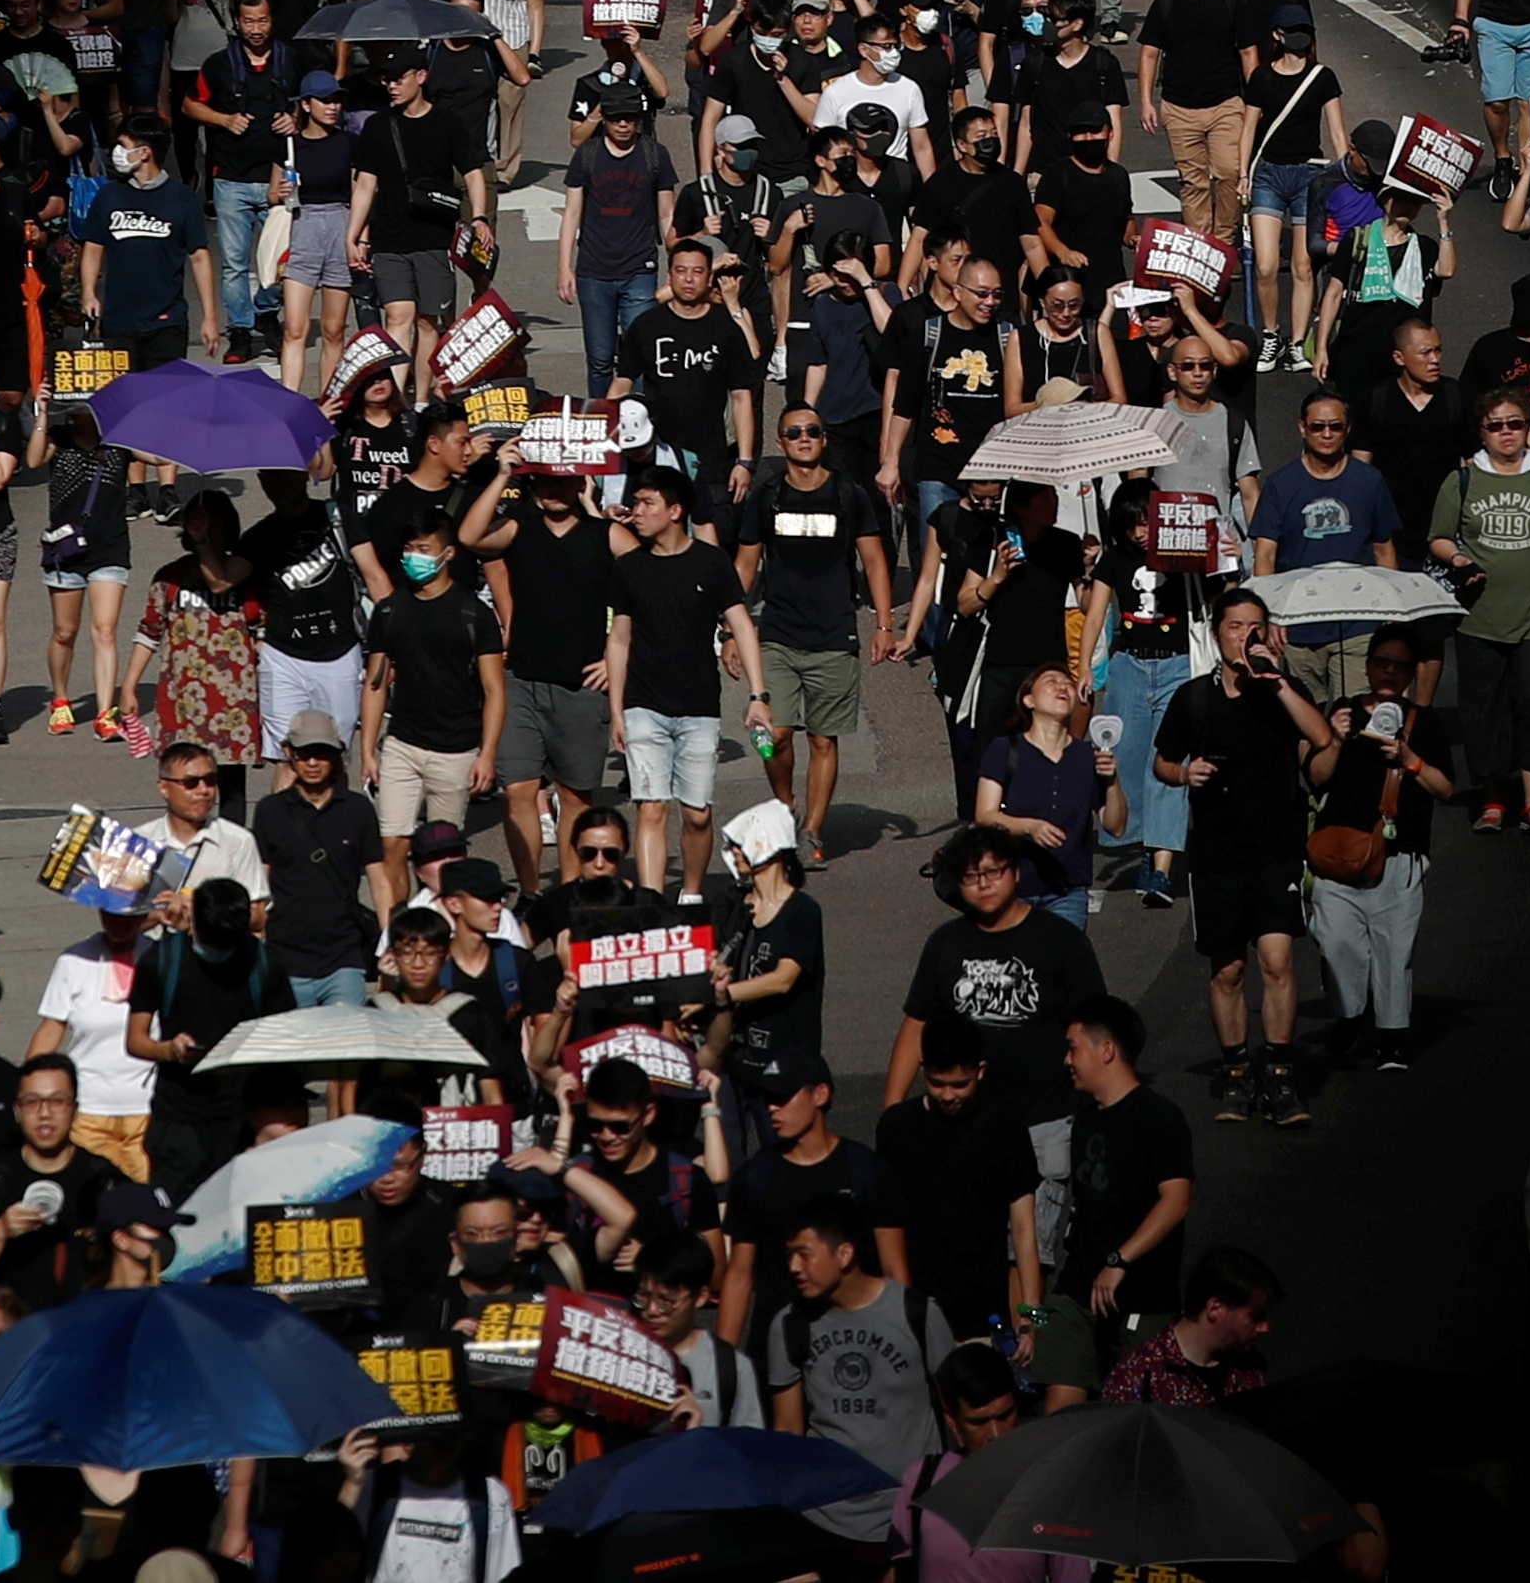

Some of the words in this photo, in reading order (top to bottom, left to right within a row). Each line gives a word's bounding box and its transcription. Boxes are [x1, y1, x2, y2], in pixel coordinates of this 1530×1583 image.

[592, 2, 660, 24] 撤銷檢控
[1418, 125, 1475, 173] 平反暴動
[109, 210, 172, 234] Dickies
[1152, 228, 1227, 274] 平反暴動
[1146, 249, 1220, 296] 撤銷檢控
[54, 349, 130, 372] 全面撤回
[53, 369, 128, 393] 送中惡
[1487, 515, 1524, 536] 1919
[281, 541, 337, 591] POLITE
[590, 924, 694, 961] 成立獨立
[577, 947, 708, 989] 調查委員會
[580, 1033, 692, 1064] 平反暴動
[253, 1215, 365, 1253] 全面撤回
[253, 1248, 369, 1285] 送中惡法
[480, 1301, 548, 1328] 全面
[469, 1351, 485, 1363] NO
[559, 1304, 676, 1379] 平反暴動
[553, 1336, 678, 1405] 撤銷檢控
[832, 1397, 878, 1414] 1892
